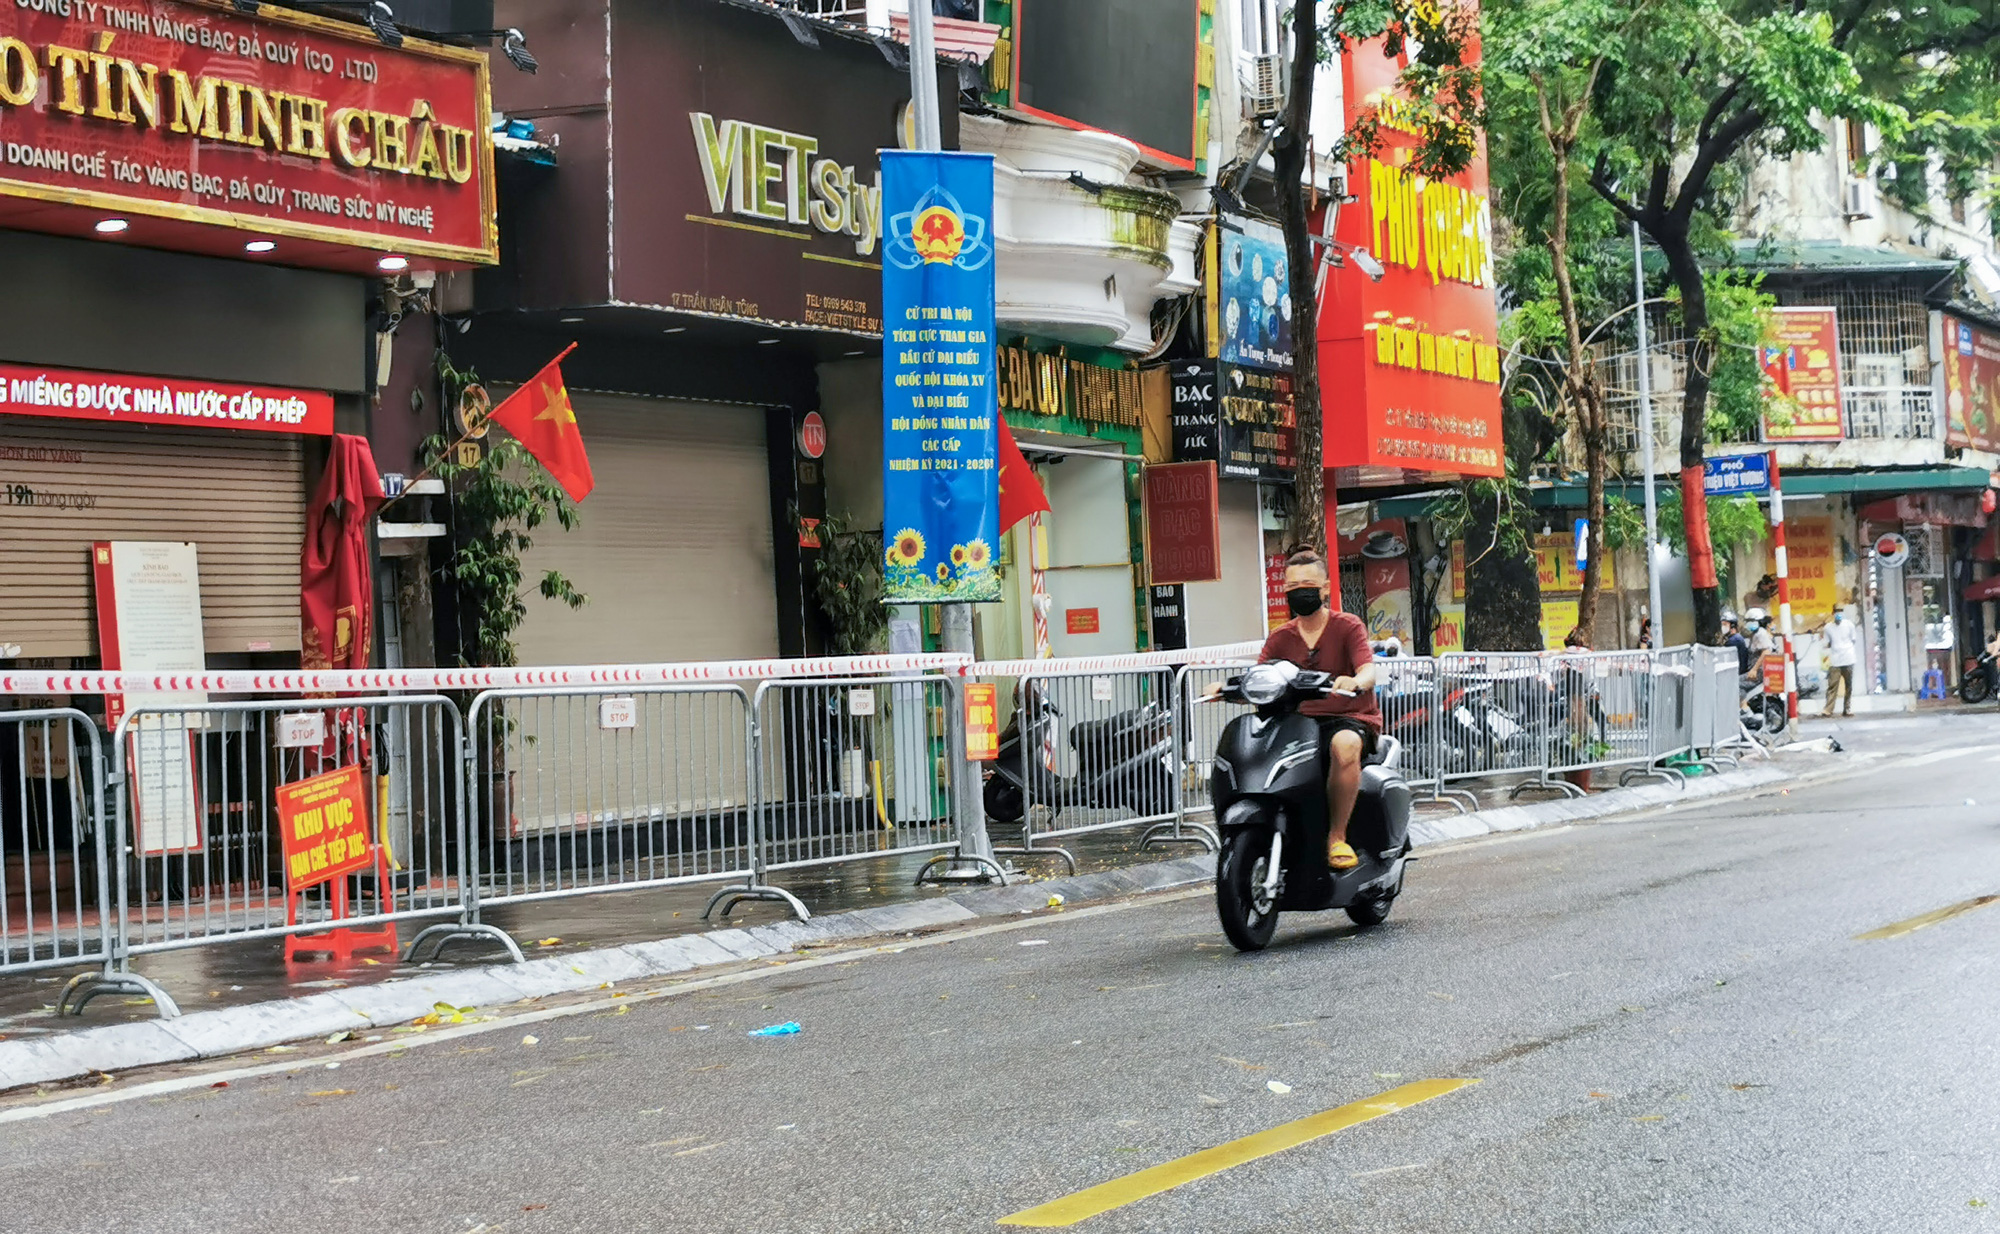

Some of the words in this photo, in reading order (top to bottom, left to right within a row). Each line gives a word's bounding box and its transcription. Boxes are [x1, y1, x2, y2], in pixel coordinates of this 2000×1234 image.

[76, 1, 97, 22] TY
[103, 6, 149, 34] TNHH
[152, 14, 197, 44] VÀNG
[200, 28, 235, 52] BẠC
[265, 41, 298, 65] QUÝ
[48, 30, 159, 130] TÍN
[169, 68, 330, 158] MINH
[333, 99, 473, 184] CHÂU
[8, 143, 68, 172] DOANH
[72, 151, 106, 178] CHẾ
[111, 155, 142, 183] TÁC
[146, 161, 188, 190] VÀNG
[292, 189, 341, 215] TRANG
[345, 194, 373, 219] SỨC
[376, 200, 396, 222] MỸ
[398, 206, 434, 234] NGHỆ
[922, 308, 937, 319] TRI
[941, 303, 953, 320] HÀ
[955, 307, 972, 322] NỘI
[893, 328, 916, 343] TÍCH
[940, 330, 966, 343] THAM
[968, 331, 986, 343] GIA
[895, 371, 922, 386] QUỐC
[924, 373, 940, 387] HỘI
[943, 372, 969, 386] KHÓA
[972, 375, 985, 386] XV
[11, 374, 73, 408] MIẾNG
[76, 382, 132, 416] ĐƯỢC
[133, 385, 174, 414] NHÀ
[176, 389, 228, 418] NƯỚC
[229, 390, 264, 420] CẤP
[265, 396, 307, 424] PHÉP
[912, 394, 924, 408] VÀ
[927, 396, 944, 409] ĐẠI
[1174, 384, 1213, 407] BẠC
[891, 418, 910, 432] HỘI
[941, 416, 967, 430] NHÂN
[969, 416, 990, 430] DÂN
[1173, 414, 1217, 427] TRANG
[922, 437, 939, 451] CÁC
[942, 436, 961, 452] CẤP
[463, 446, 476, 464] 17
[889, 457, 919, 472] NHIỆM
[935, 459, 958, 470] 2021
[1152, 470, 1206, 504] VÀNG
[610, 713, 629, 722] STOP
[292, 729, 315, 740] STOP
[293, 807, 324, 841] KHU
[325, 797, 354, 833] VỰC
[347, 828, 365, 860] XÚC
